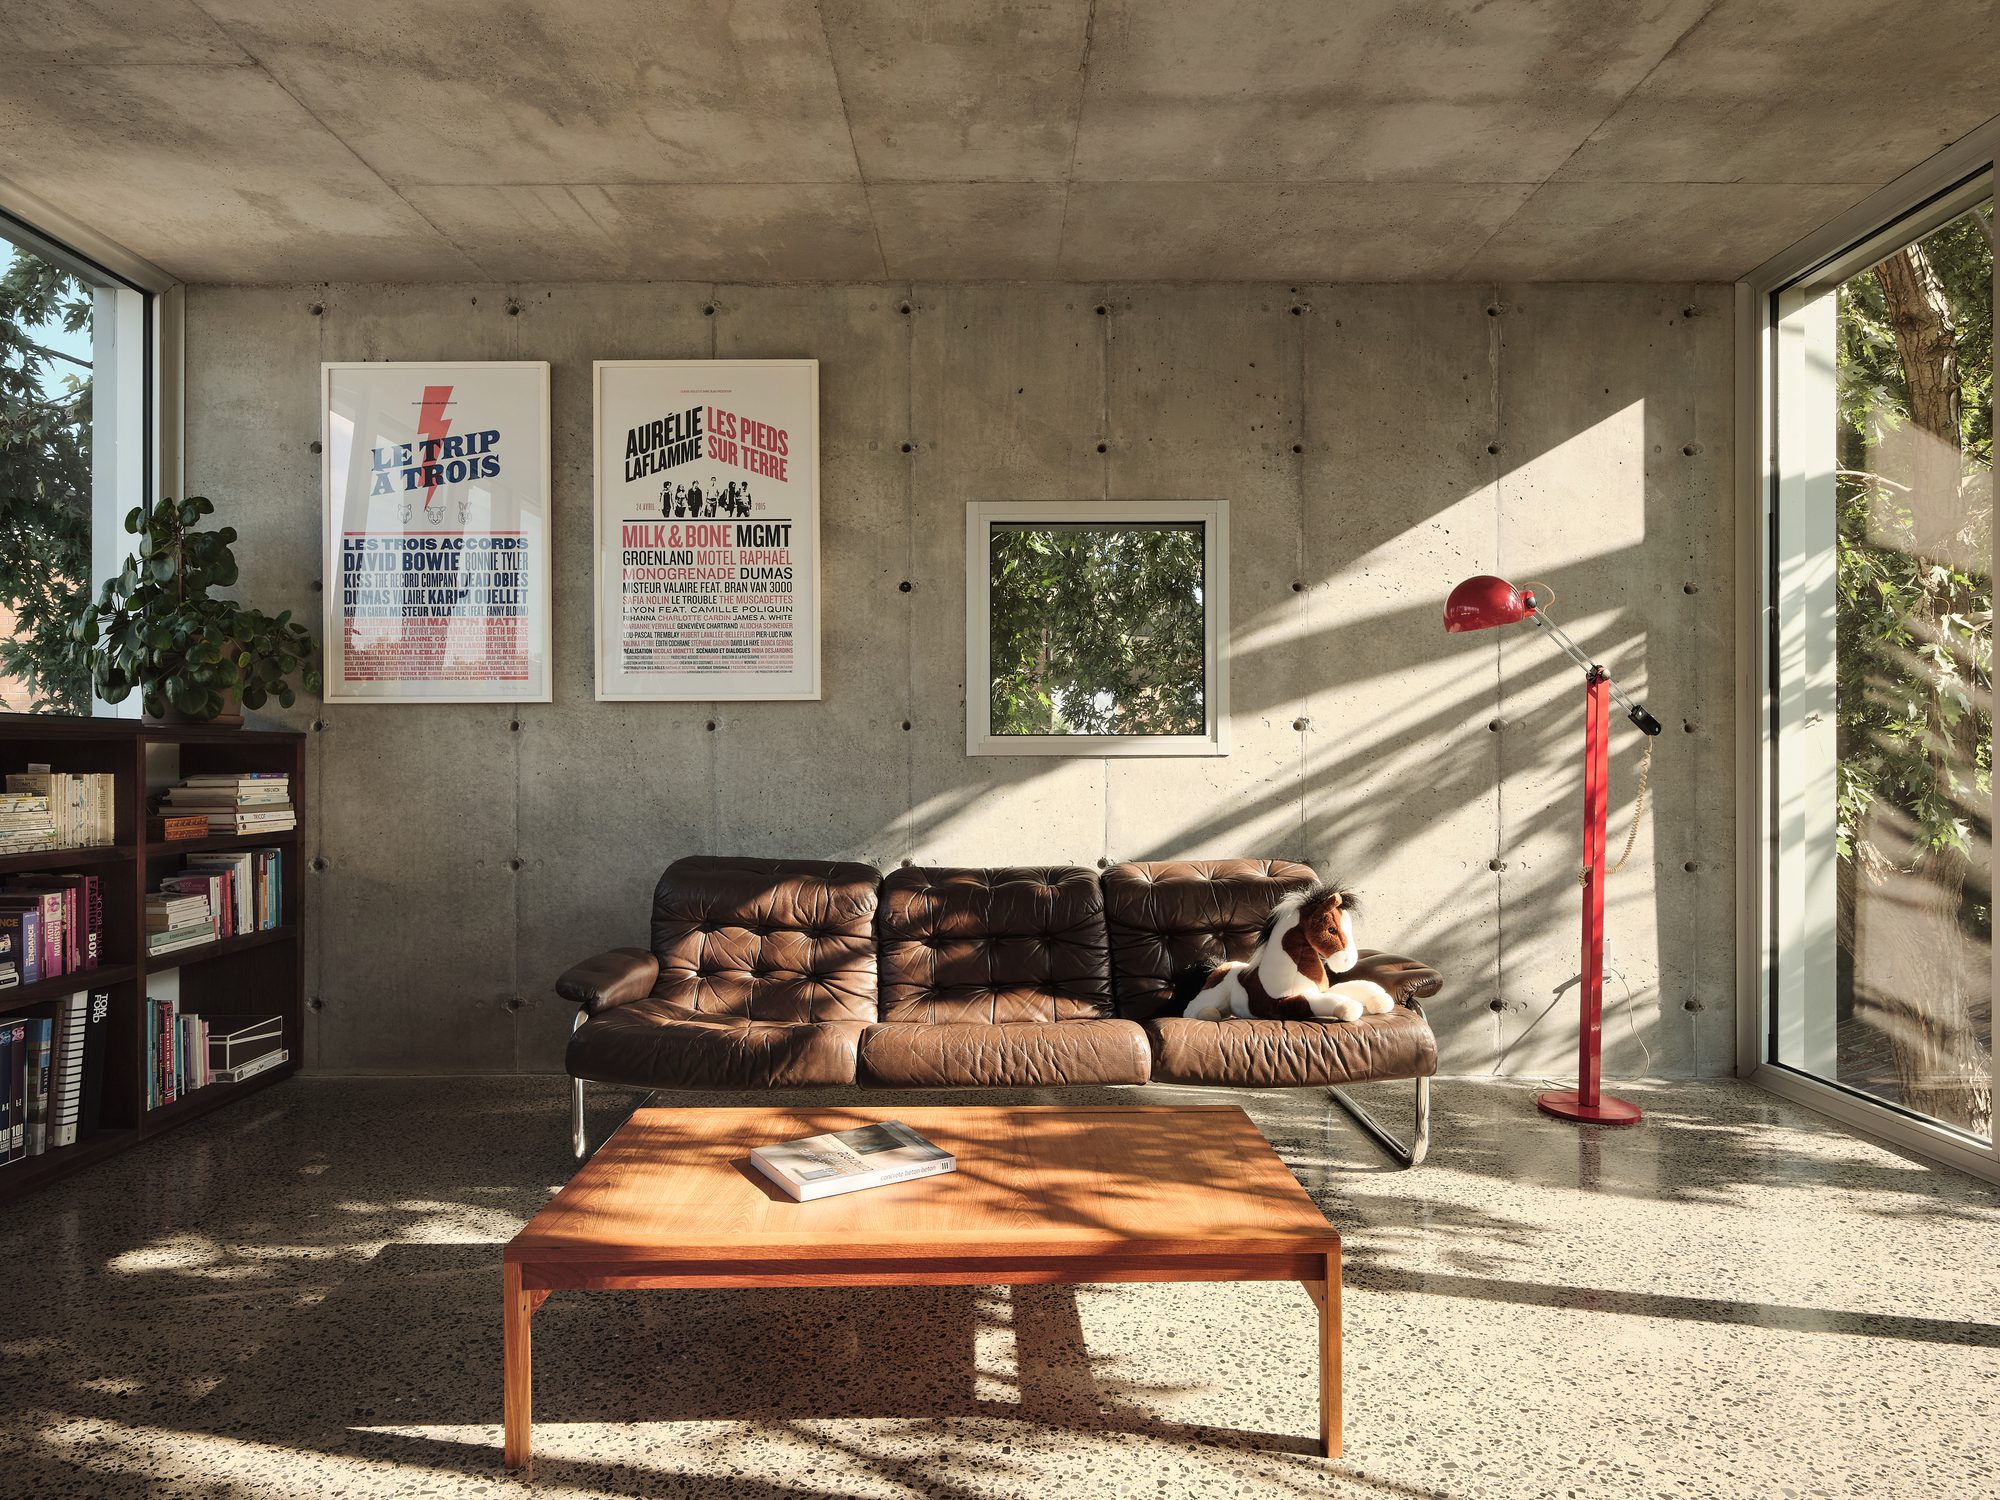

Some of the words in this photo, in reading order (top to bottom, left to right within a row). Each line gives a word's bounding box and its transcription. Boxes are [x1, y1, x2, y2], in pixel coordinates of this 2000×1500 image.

[625, 406, 702, 460] AURÉLIE
[708, 406, 736, 439] LES
[741, 416, 788, 456] PIEDS
[370, 444, 412, 471] LE
[419, 430, 500, 462] TRIP
[625, 436, 702, 483] LAFLAMME
[708, 435, 738, 467] SUR
[741, 445, 788, 483] TERRE
[401, 454, 500, 491] TROIS
[344, 538, 379, 550] LES
[381, 538, 437, 550] TROIS
[440, 538, 528, 550] ACCORDS
[623, 525, 665, 548] MILK
[668, 525, 683, 548] &
[686, 525, 732, 548] BONE
[737, 524, 792, 548] MGMT
[344, 552, 396, 571] DAVID
[402, 552, 460, 571] BOWIE
[465, 552, 498, 571] BONNIE
[501, 552, 528, 571] TYLER
[623, 550, 693, 565] GROENLAND
[697, 550, 736, 565] MOTEL
[740, 548, 792, 565] RAPHAËL
[344, 573, 372, 588] KISS
[375, 573, 388, 588] THE
[390, 573, 419, 588] RECORD
[421, 573, 458, 588] COMPANY
[461, 573, 490, 588] DEAD
[494, 573, 528, 588] OBIES
[623, 567, 735, 580] MONOGRENADE
[740, 567, 792, 580] DUMAS
[344, 589, 390, 604] DUMAS
[393, 589, 425, 604] VALAIRE
[428, 589, 471, 604] KARIM
[474, 589, 528, 604] OUELLET
[623, 582, 661, 593] MISTEUR
[663, 582, 698, 593] VALAIRE
[700, 582, 722, 593] FEAT.
[724, 582, 748, 593] BRAN
[750, 582, 767, 593] VAN
[770, 582, 792, 593] 3000
[623, 596, 644, 604] SAFIA
[646, 596, 669, 604] NOLIN
[672, 596, 680, 604] LE
[682, 596, 717, 604] TROUBLE
[719, 596, 734, 604] THE
[736, 596, 793, 604] MUSCADETTES
[389, 606, 428, 617] MISTEUR
[431, 606, 466, 617] VALAIRE
[486, 606, 504, 617] FANNY
[88, 880, 96, 933] FASHION
[88, 933, 96, 959] BOX
[93, 994, 101, 1024] FORD
[100, 992, 109, 1017] TOM
